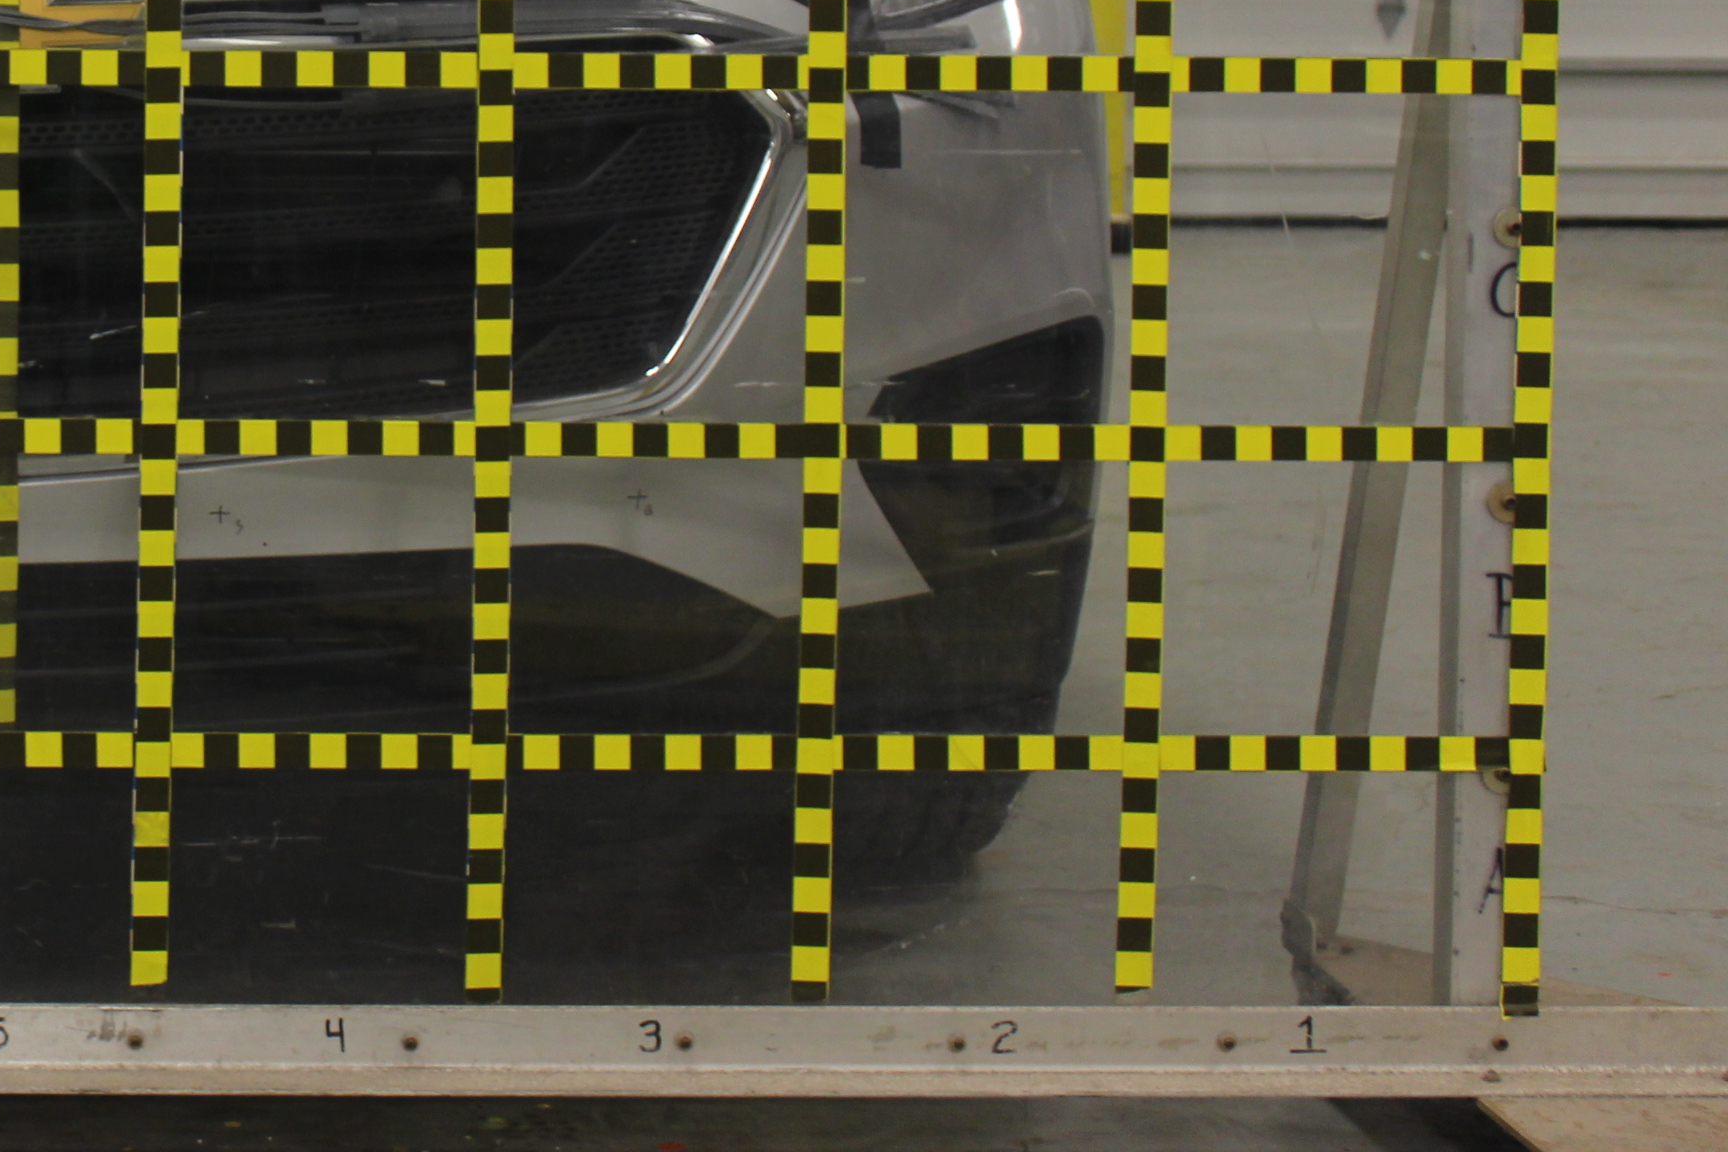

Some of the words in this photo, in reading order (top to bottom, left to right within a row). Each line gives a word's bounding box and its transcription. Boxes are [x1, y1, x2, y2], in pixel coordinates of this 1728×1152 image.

[325, 1017, 345, 1053] 4
[639, 1019, 662, 1053] 3
[991, 1020, 1018, 1055] 2
[1289, 1015, 1327, 1054] 1
